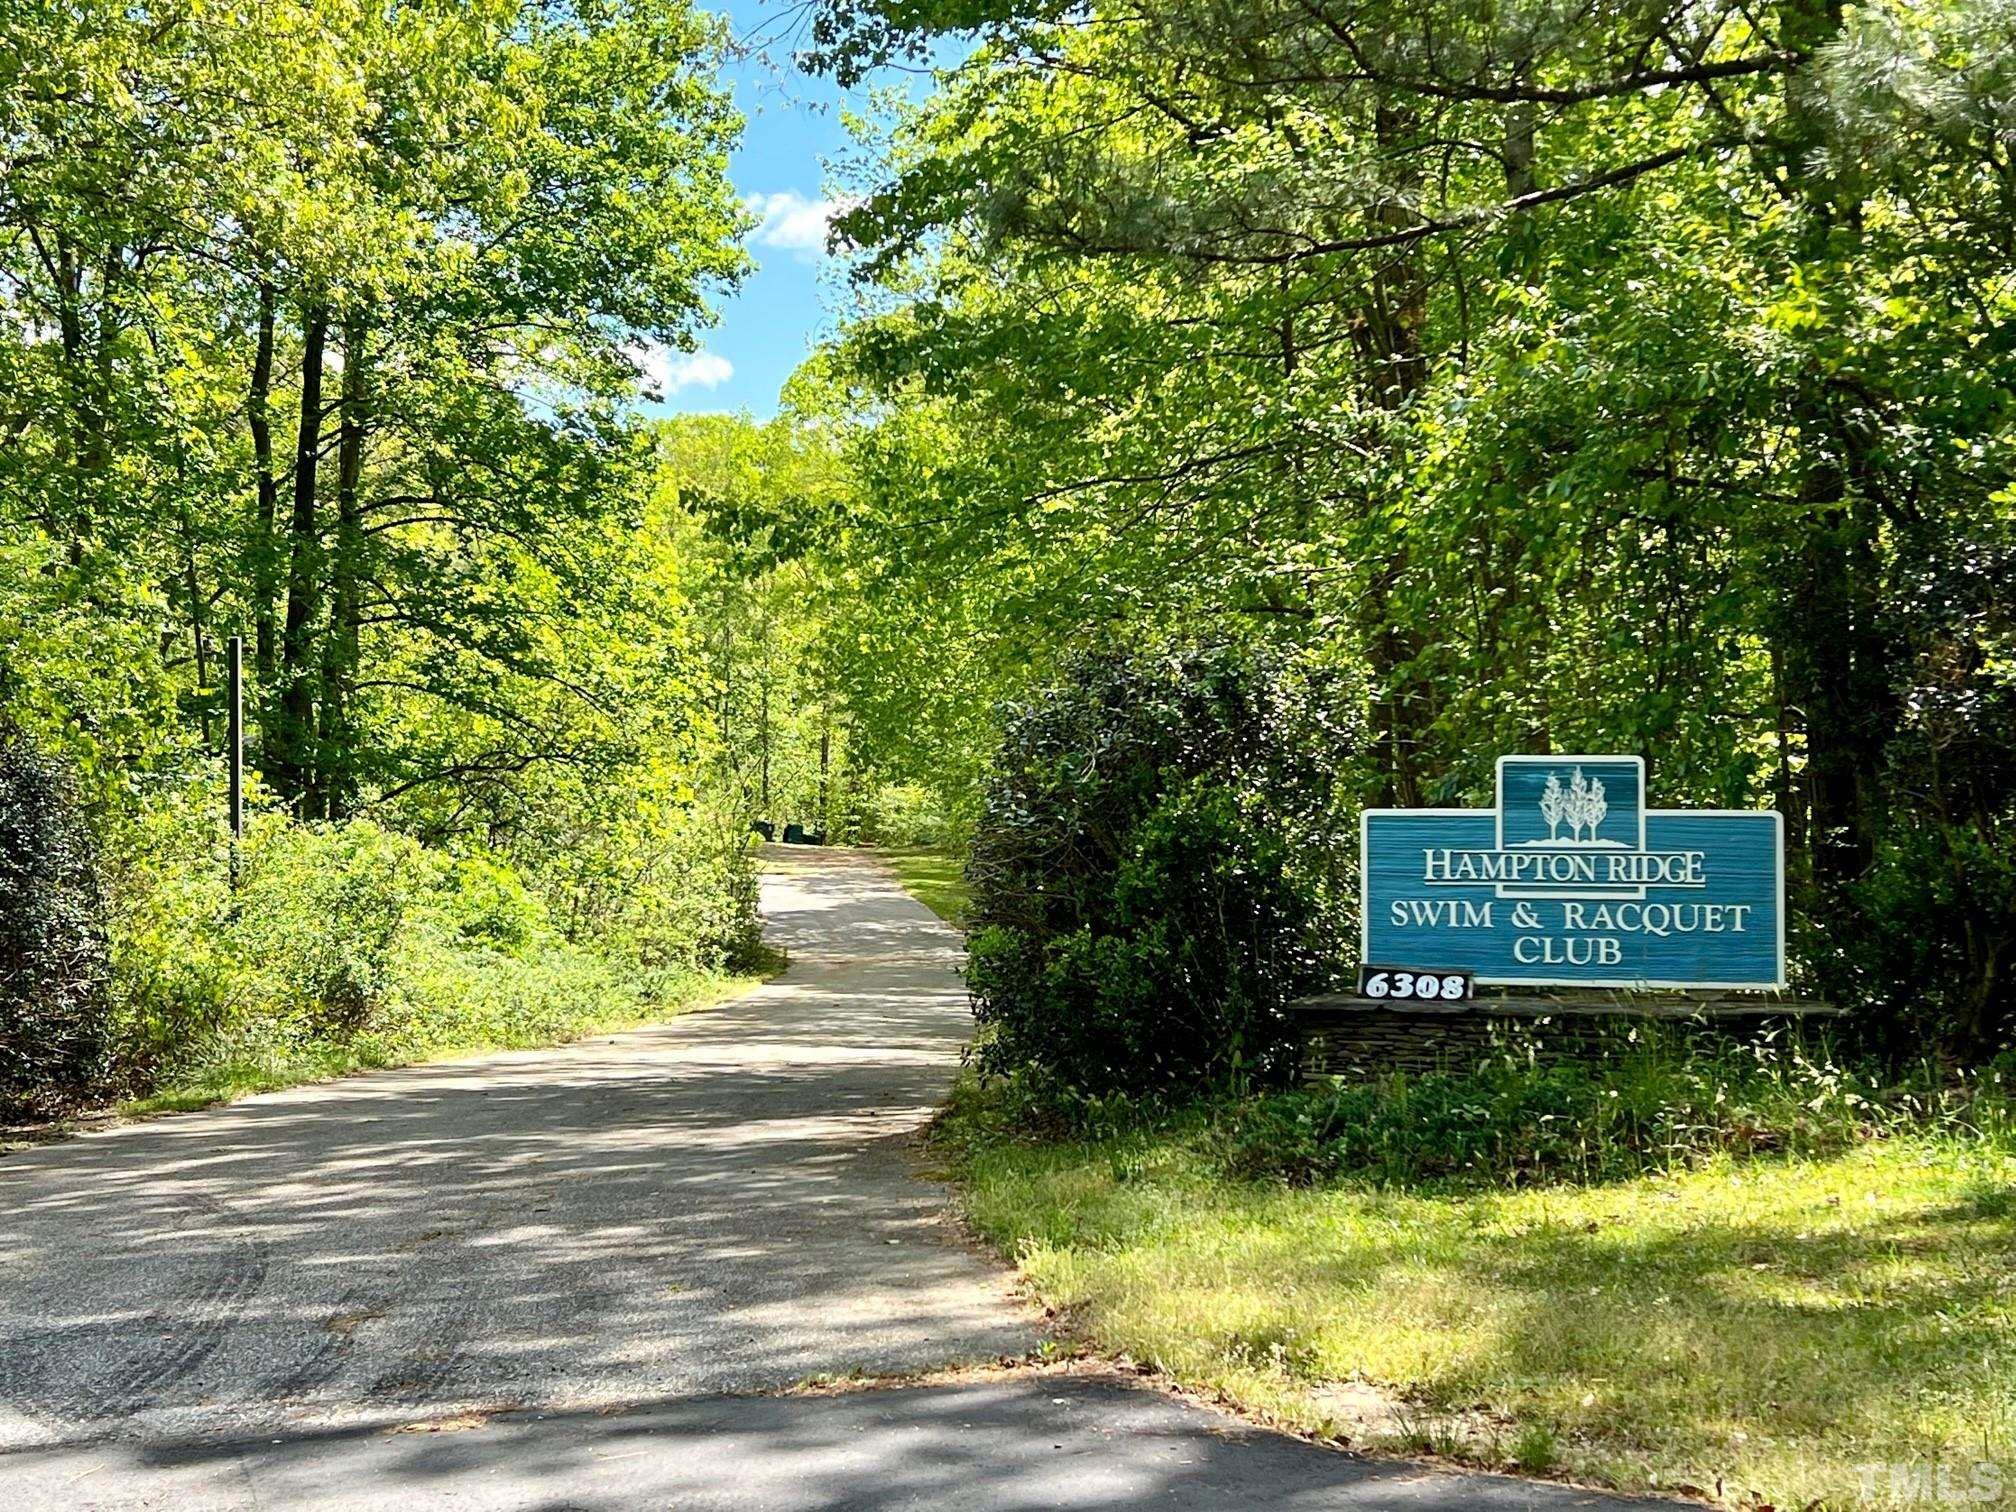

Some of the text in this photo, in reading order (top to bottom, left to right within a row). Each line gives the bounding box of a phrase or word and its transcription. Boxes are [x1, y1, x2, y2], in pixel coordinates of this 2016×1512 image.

[1423, 849, 1706, 885] HAMPTON RIDGE
[1390, 900, 1751, 936] SWIM & RACQUET
[1513, 937, 1622, 965] CLUB
[1365, 973, 1464, 1000] 6308
